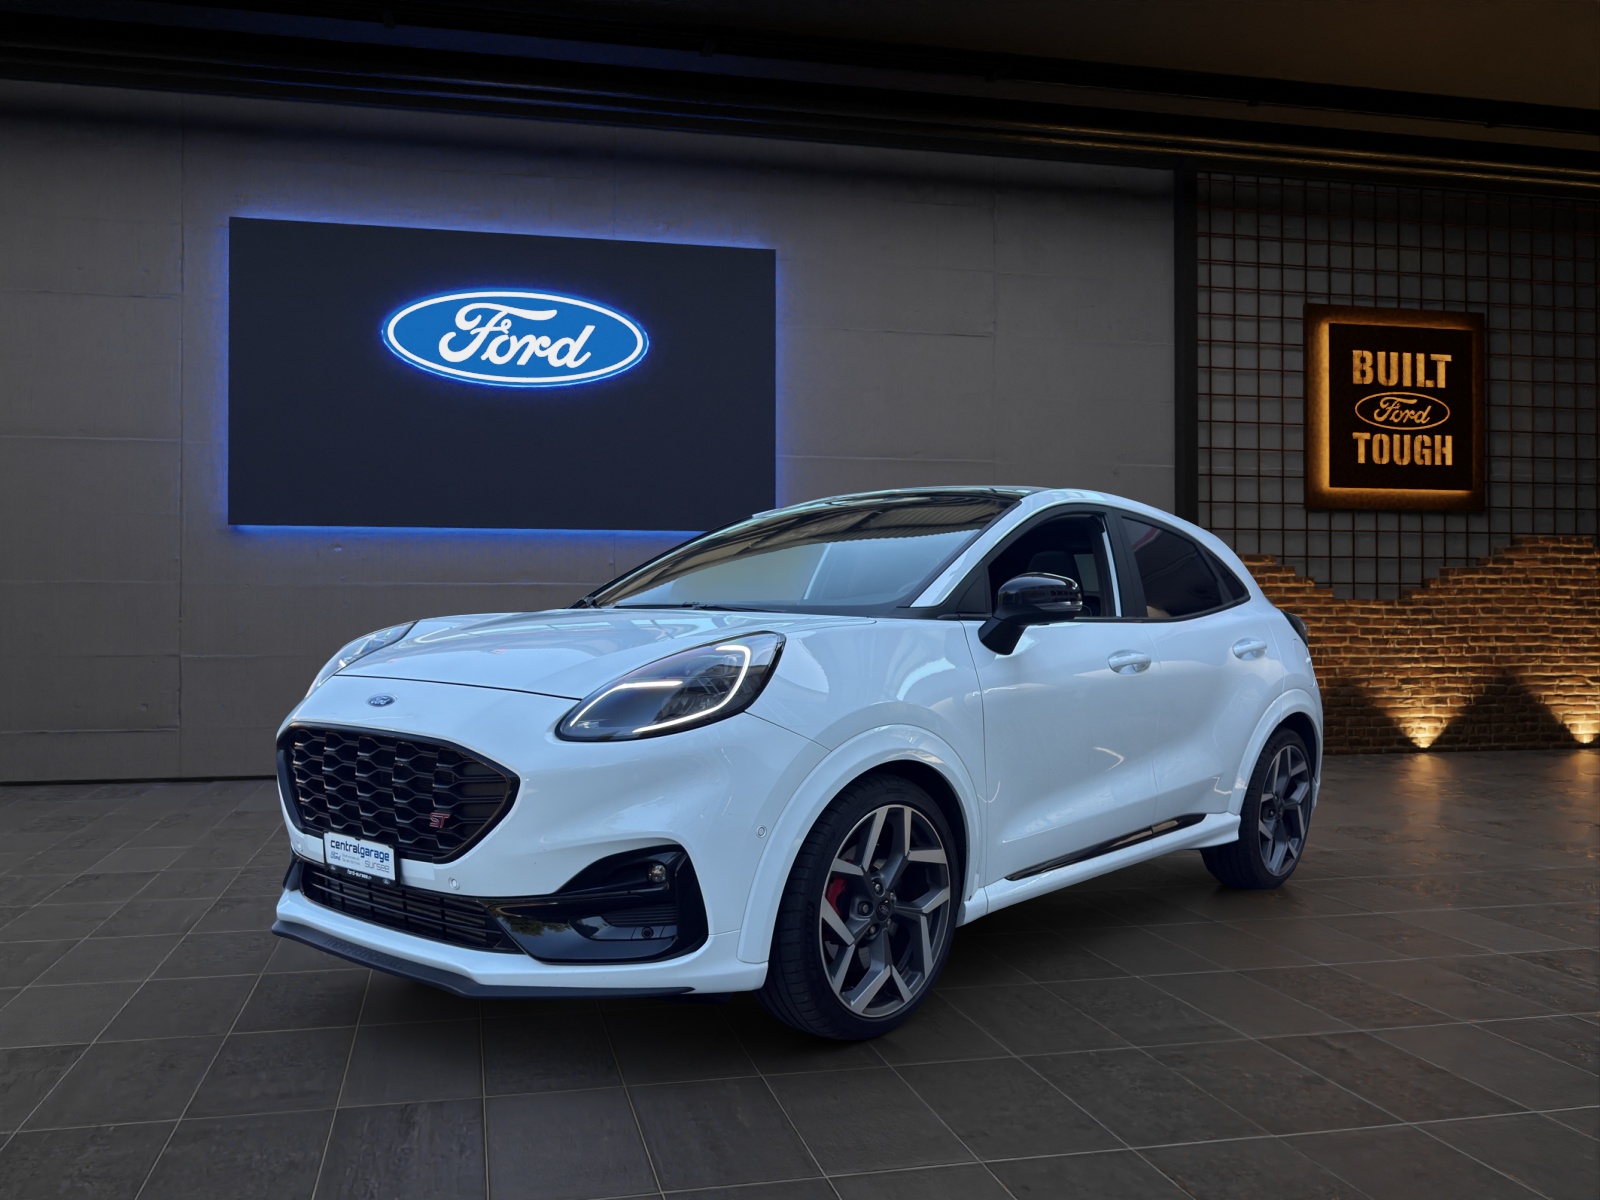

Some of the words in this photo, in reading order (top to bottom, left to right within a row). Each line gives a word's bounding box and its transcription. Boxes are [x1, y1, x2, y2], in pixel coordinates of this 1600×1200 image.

[439, 302, 595, 368] Ford
[1352, 350, 1452, 388] BUILT
[1373, 396, 1432, 424] Ford
[1352, 432, 1453, 466] TOUGH
[429, 812, 450, 828] ST
[330, 839, 390, 863] centralgarage
[364, 860, 390, 873] sursee
